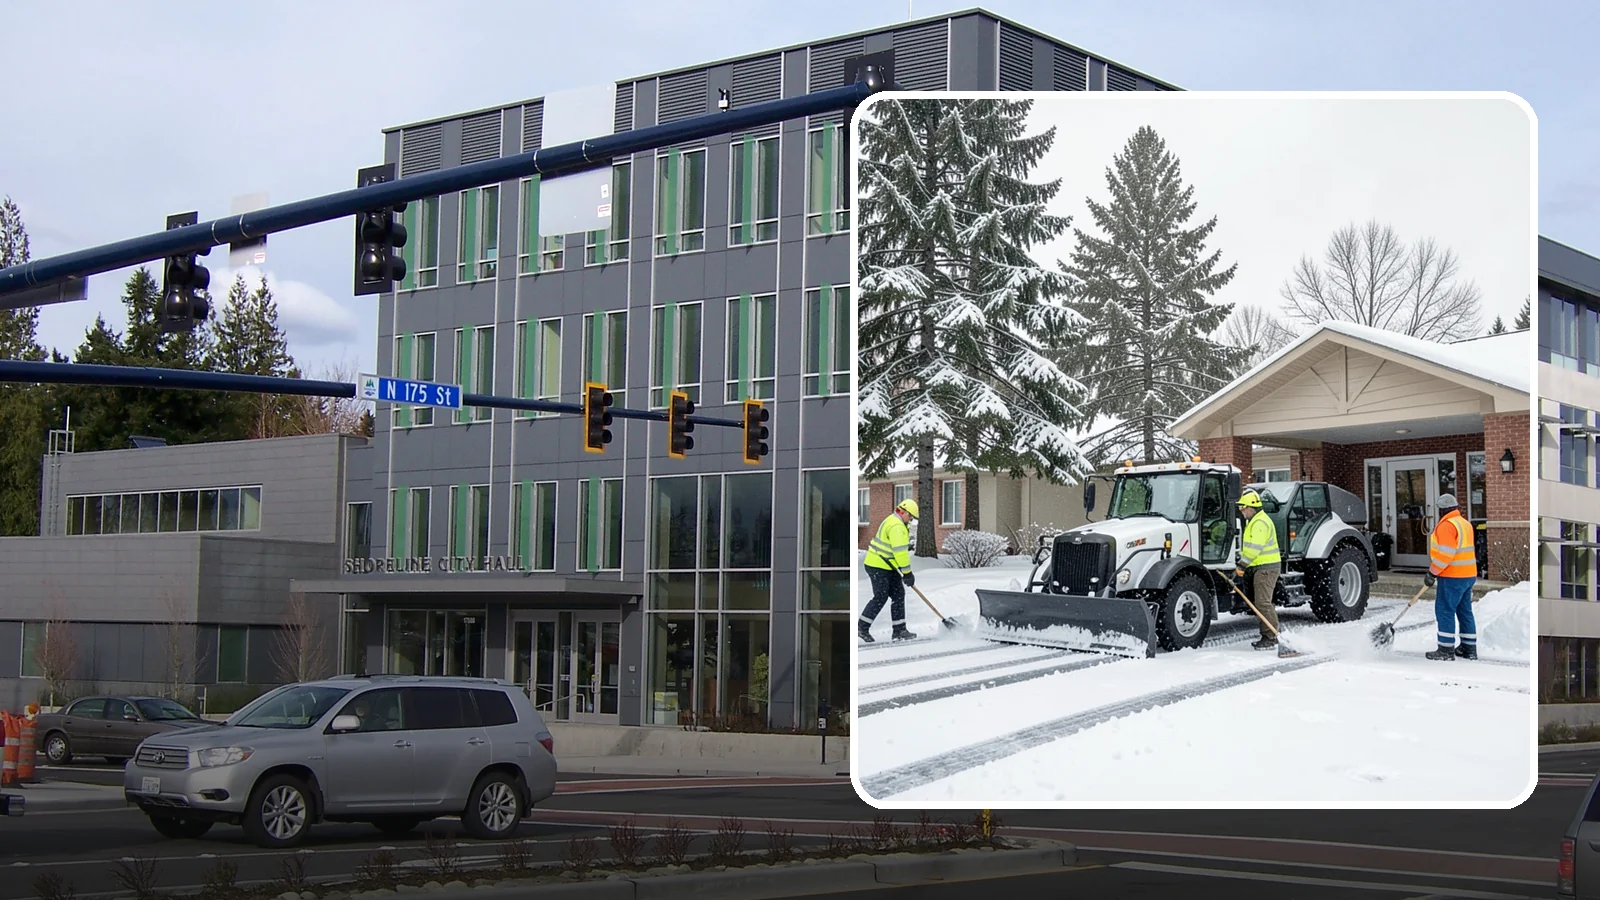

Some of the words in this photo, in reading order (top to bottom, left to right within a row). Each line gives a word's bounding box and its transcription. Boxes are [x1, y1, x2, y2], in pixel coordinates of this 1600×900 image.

[387, 380, 396, 400] N
[405, 382, 427, 403] 175
[436, 386, 451, 406] St
[344, 557, 431, 574] SHORELINE
[439, 557, 475, 573] CITY
[483, 556, 525, 571] HALL
